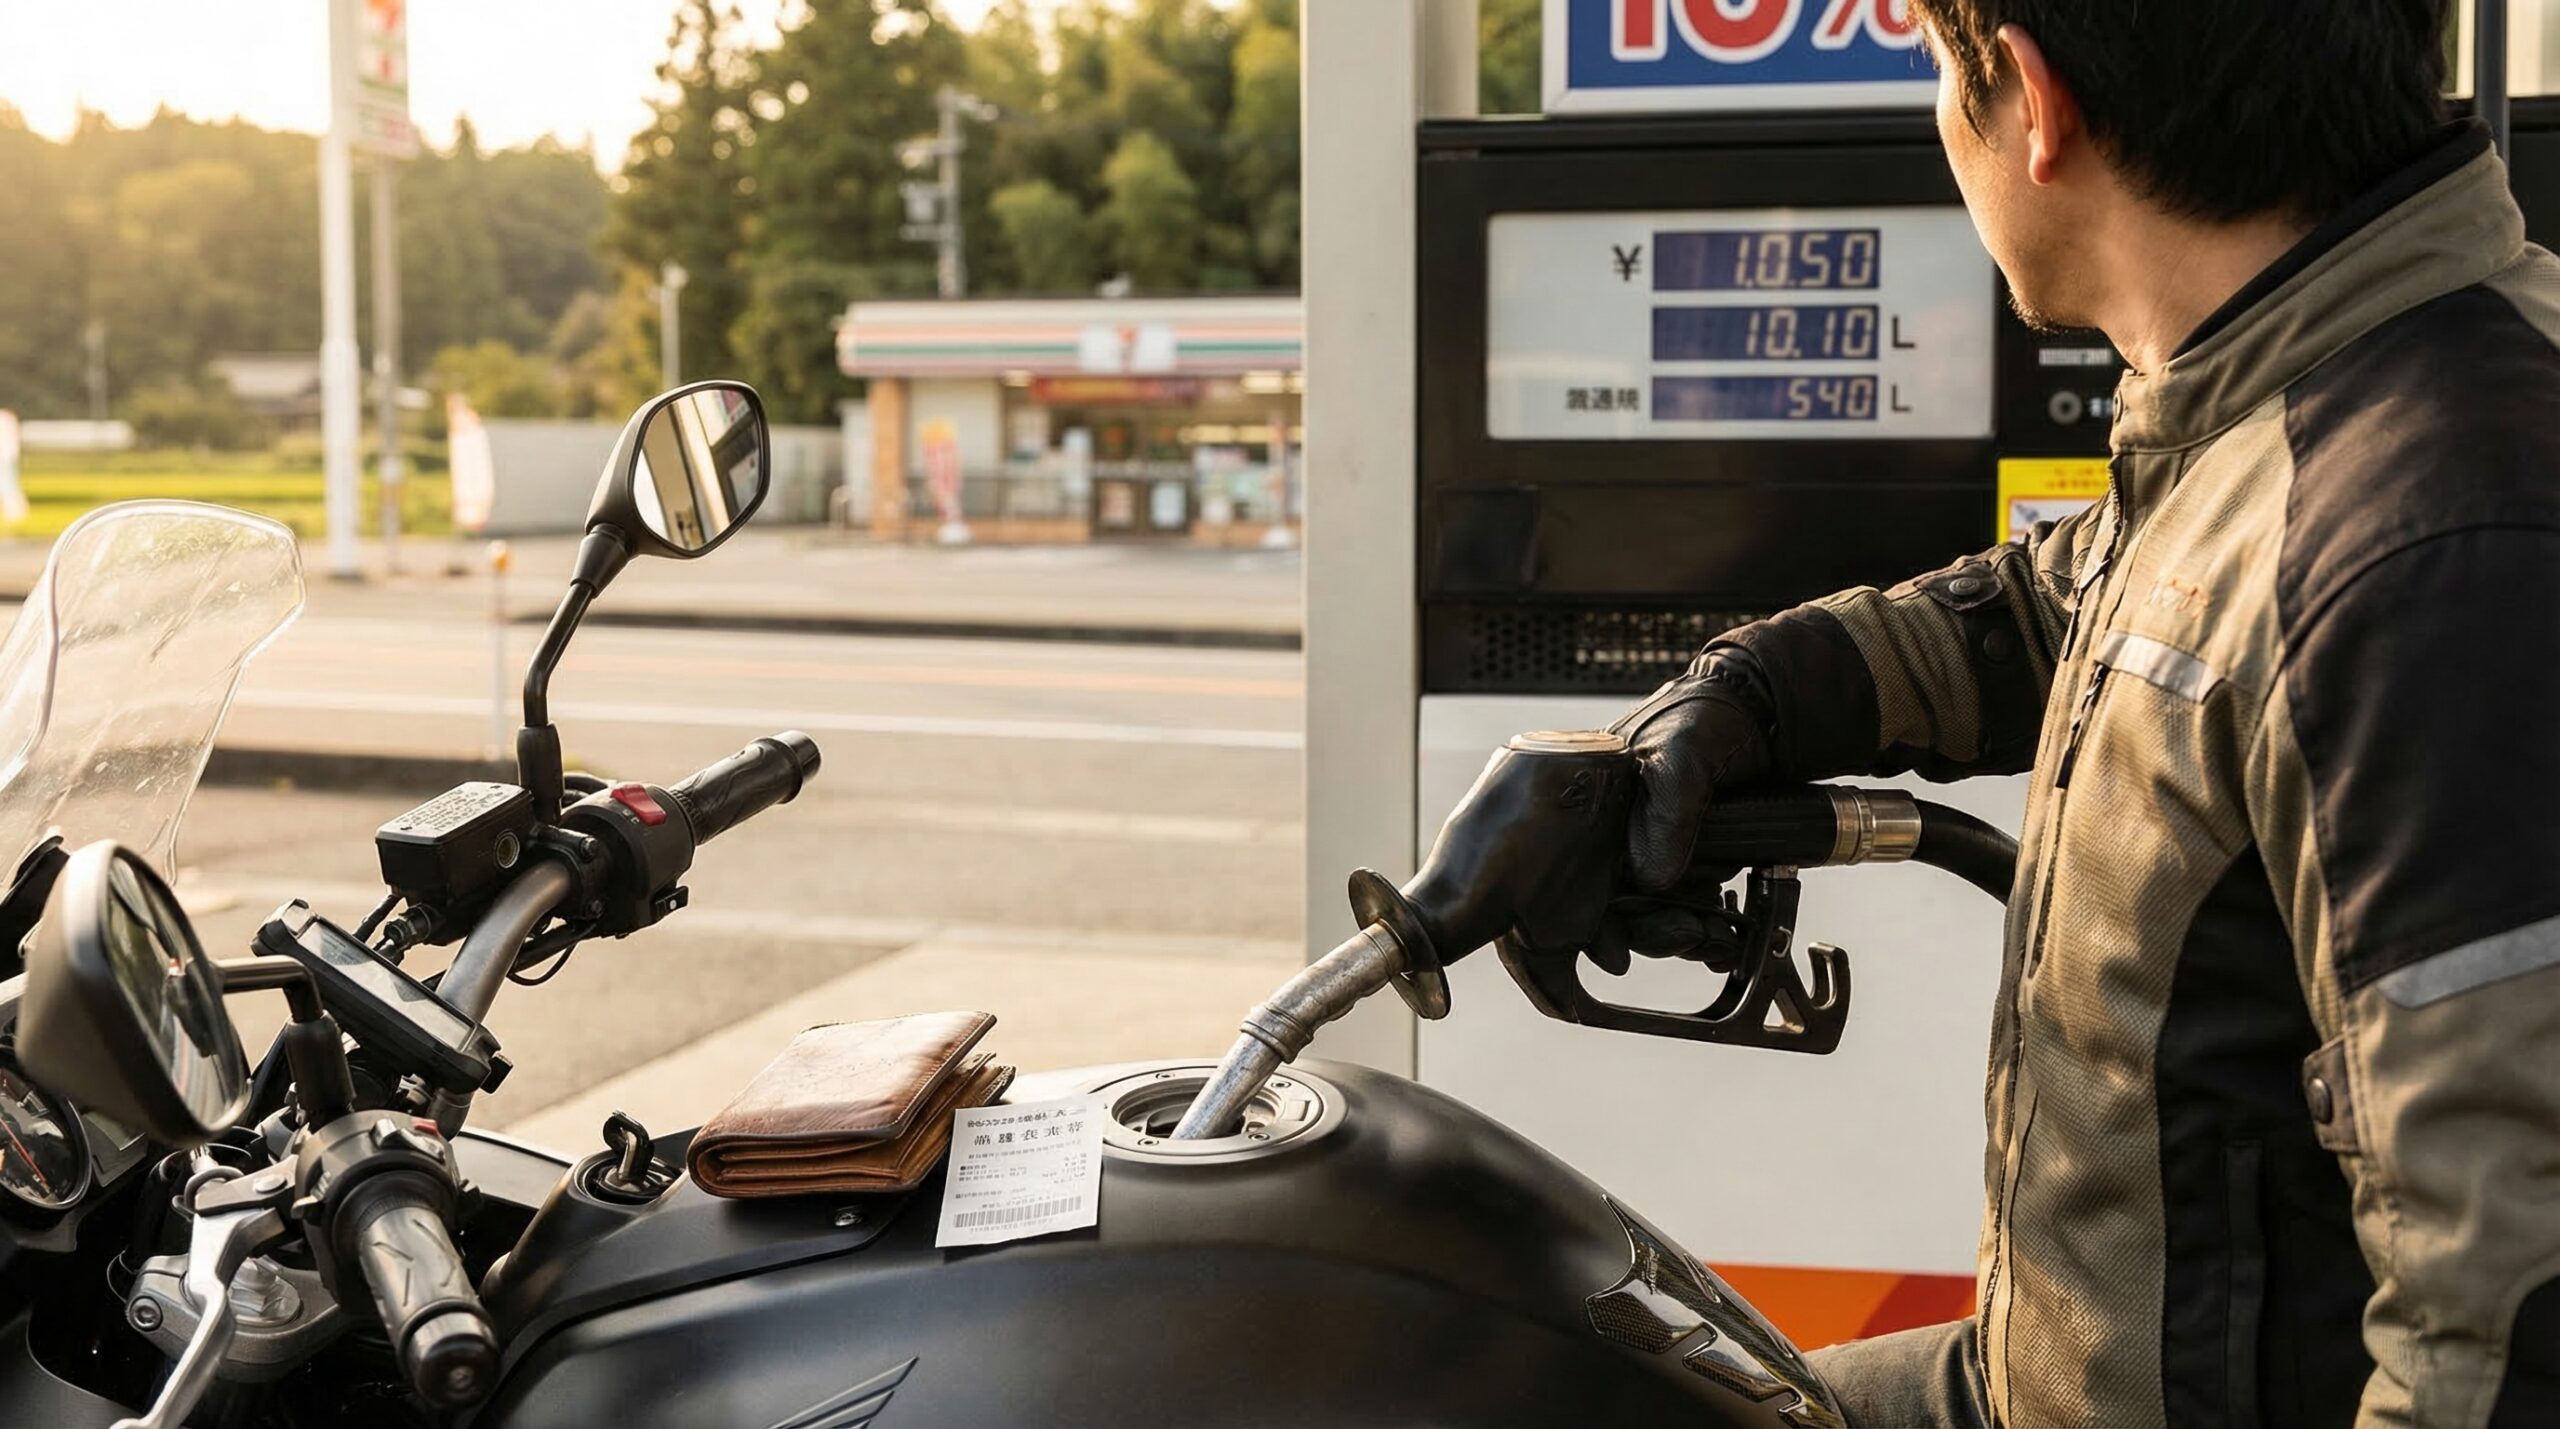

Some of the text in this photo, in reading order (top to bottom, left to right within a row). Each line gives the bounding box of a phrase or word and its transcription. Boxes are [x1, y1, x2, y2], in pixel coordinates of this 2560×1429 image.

[1612, 245, 1641, 281] ¥
[1747, 308, 1916, 358] 10.10 L
[1787, 379, 1912, 419] 540 L
